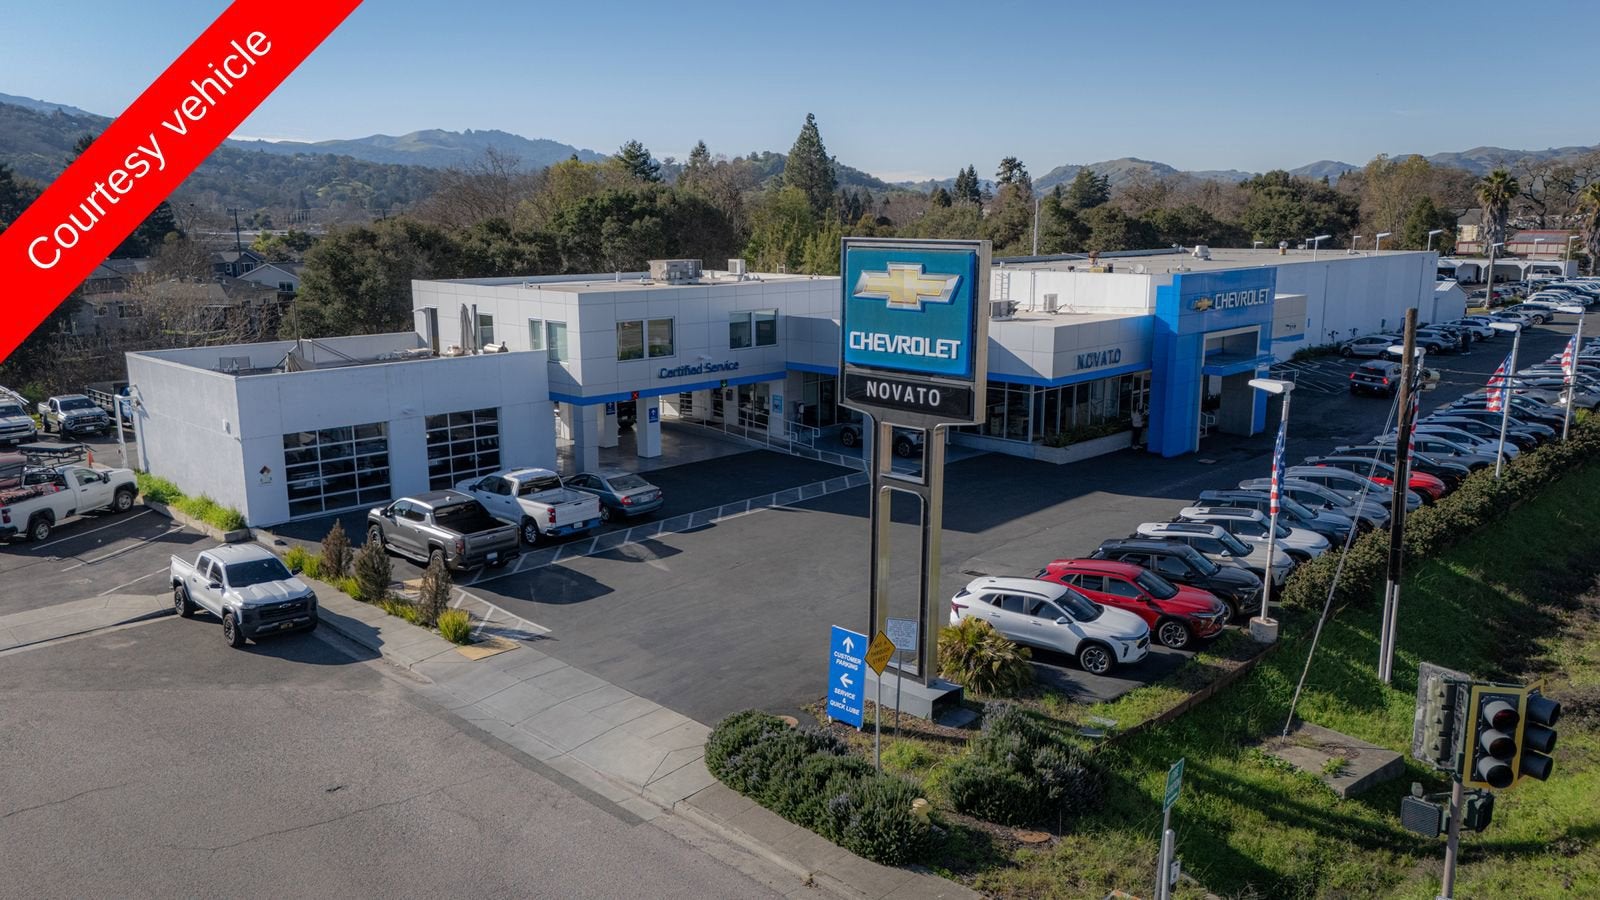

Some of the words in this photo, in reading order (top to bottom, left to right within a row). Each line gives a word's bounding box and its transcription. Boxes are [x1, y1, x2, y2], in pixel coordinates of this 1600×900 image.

[1215, 288, 1271, 311] CHEVROLET
[849, 331, 961, 360] CHEVROLET
[1076, 348, 1122, 371] NOVATO
[659, 363, 704, 379] Certified
[705, 360, 740, 373] Service
[866, 381, 941, 407] NOVATO
[833, 651, 862, 665] CUSTOMER
[835, 659, 858, 671] PARKING
[834, 687, 856, 700] SERVICE
[829, 700, 846, 711] QUICK
[846, 705, 860, 716] LUBE
